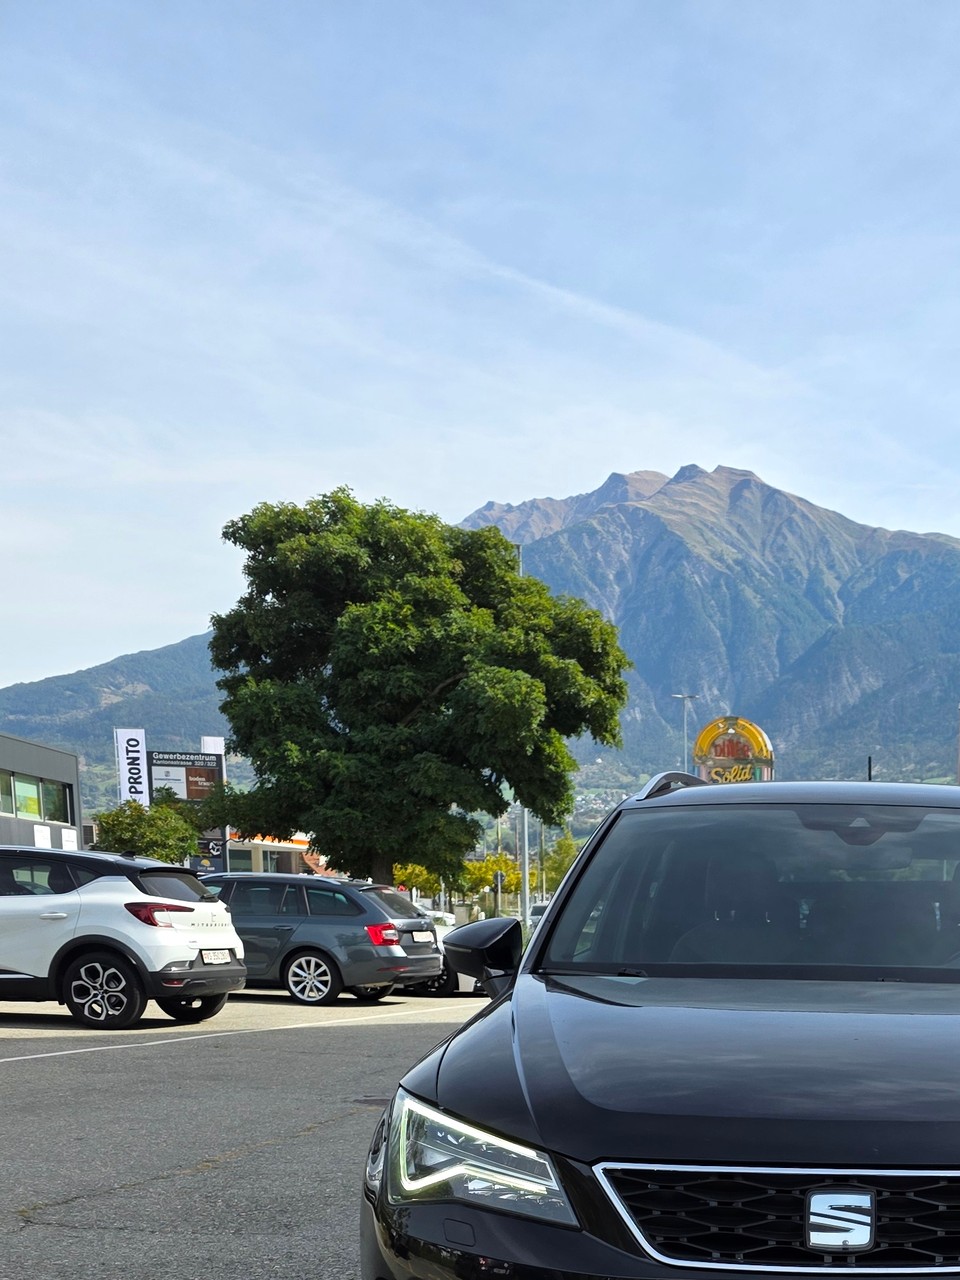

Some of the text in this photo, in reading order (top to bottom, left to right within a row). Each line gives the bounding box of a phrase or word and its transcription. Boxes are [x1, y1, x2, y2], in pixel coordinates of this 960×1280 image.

[125, 738, 144, 795] PRONTO
[152, 752, 217, 761] Gewerbezentrum
[710, 764, 753, 784] Solid
